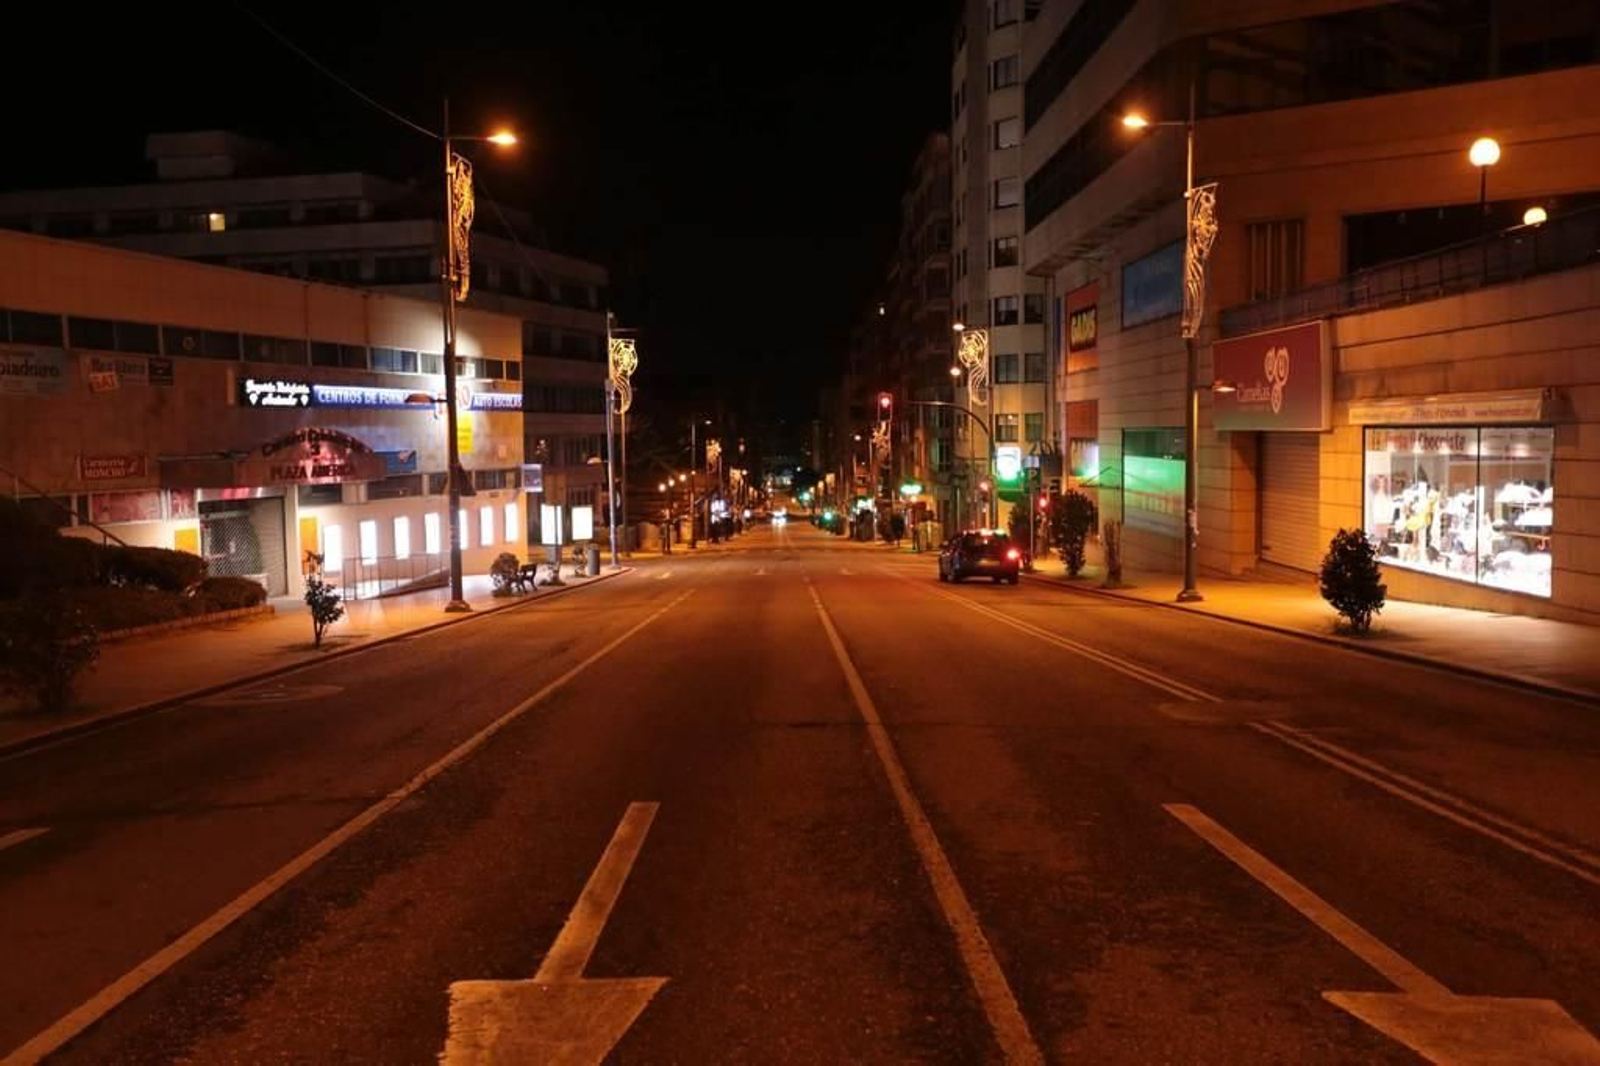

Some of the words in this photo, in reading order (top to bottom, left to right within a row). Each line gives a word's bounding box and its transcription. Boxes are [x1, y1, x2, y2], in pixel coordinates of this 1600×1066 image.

[318, 388, 363, 404] CENTROS
[364, 390, 377, 404] DE
[473, 395, 493, 407] AUTO
[270, 464, 307, 480] PLAZA
